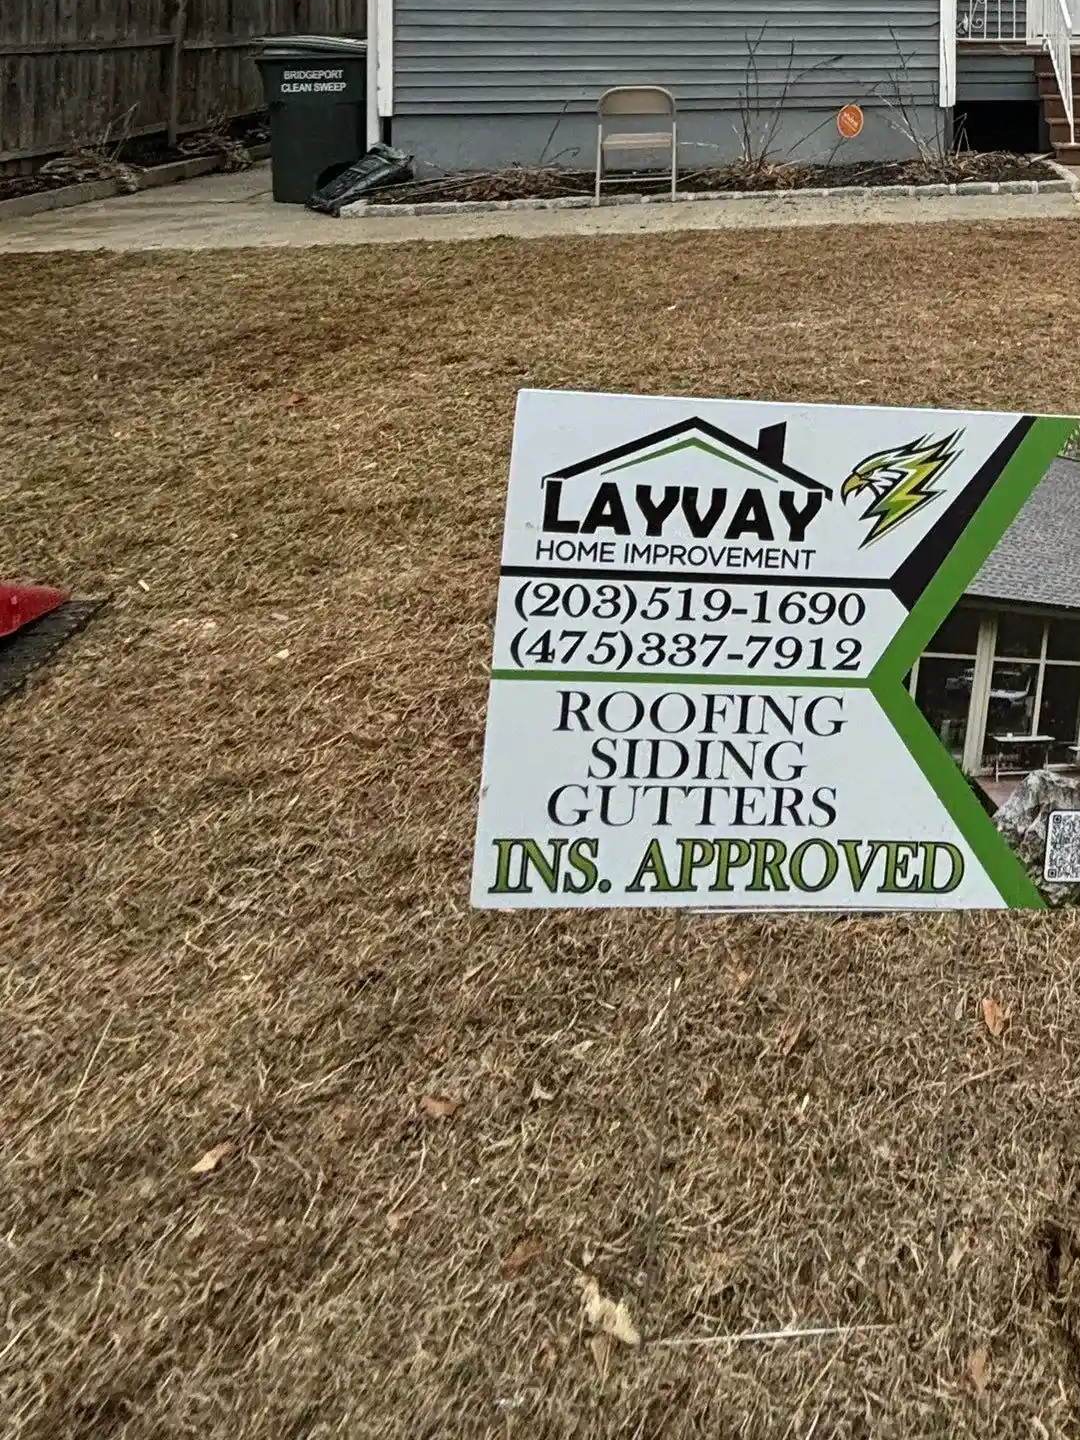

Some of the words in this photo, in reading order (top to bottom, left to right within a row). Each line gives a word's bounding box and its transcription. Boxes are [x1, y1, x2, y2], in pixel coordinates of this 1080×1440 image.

[281, 83, 312, 93] CLEAN
[313, 82, 347, 92] SWEEP
[283, 69, 344, 80] BRIDGEPORT
[542, 480, 823, 542] LAYVAY
[535, 539, 616, 563] HOME
[623, 542, 816, 570] IMPROVEMENT
[514, 580, 866, 626] (203)519-1690
[510, 627, 863, 672] (475)337-7912
[552, 690, 848, 736] ROOFING
[587, 737, 808, 782] SIDING
[547, 784, 837, 828] GUTTERS
[488, 837, 612, 894] INS.
[625, 836, 966, 895] APPROVED
